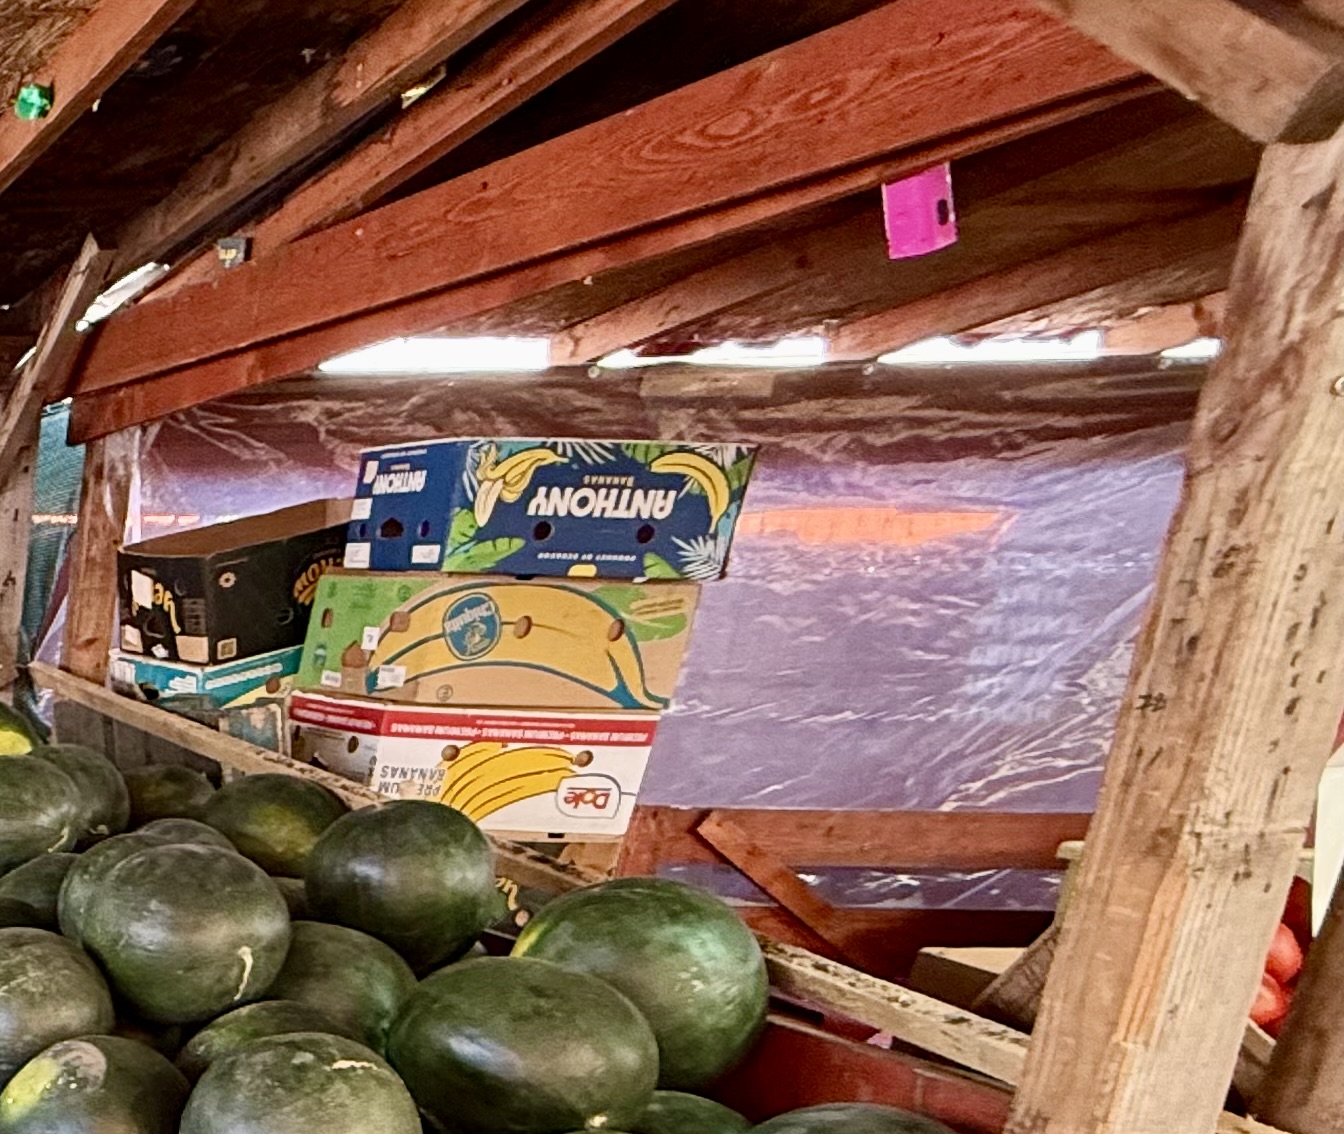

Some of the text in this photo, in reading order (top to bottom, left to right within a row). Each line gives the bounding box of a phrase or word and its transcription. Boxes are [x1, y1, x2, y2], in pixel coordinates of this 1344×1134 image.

[527, 487, 677, 519] ANTHONY
[378, 781, 442, 796] PREUM
[564, 789, 612, 810] Dole
